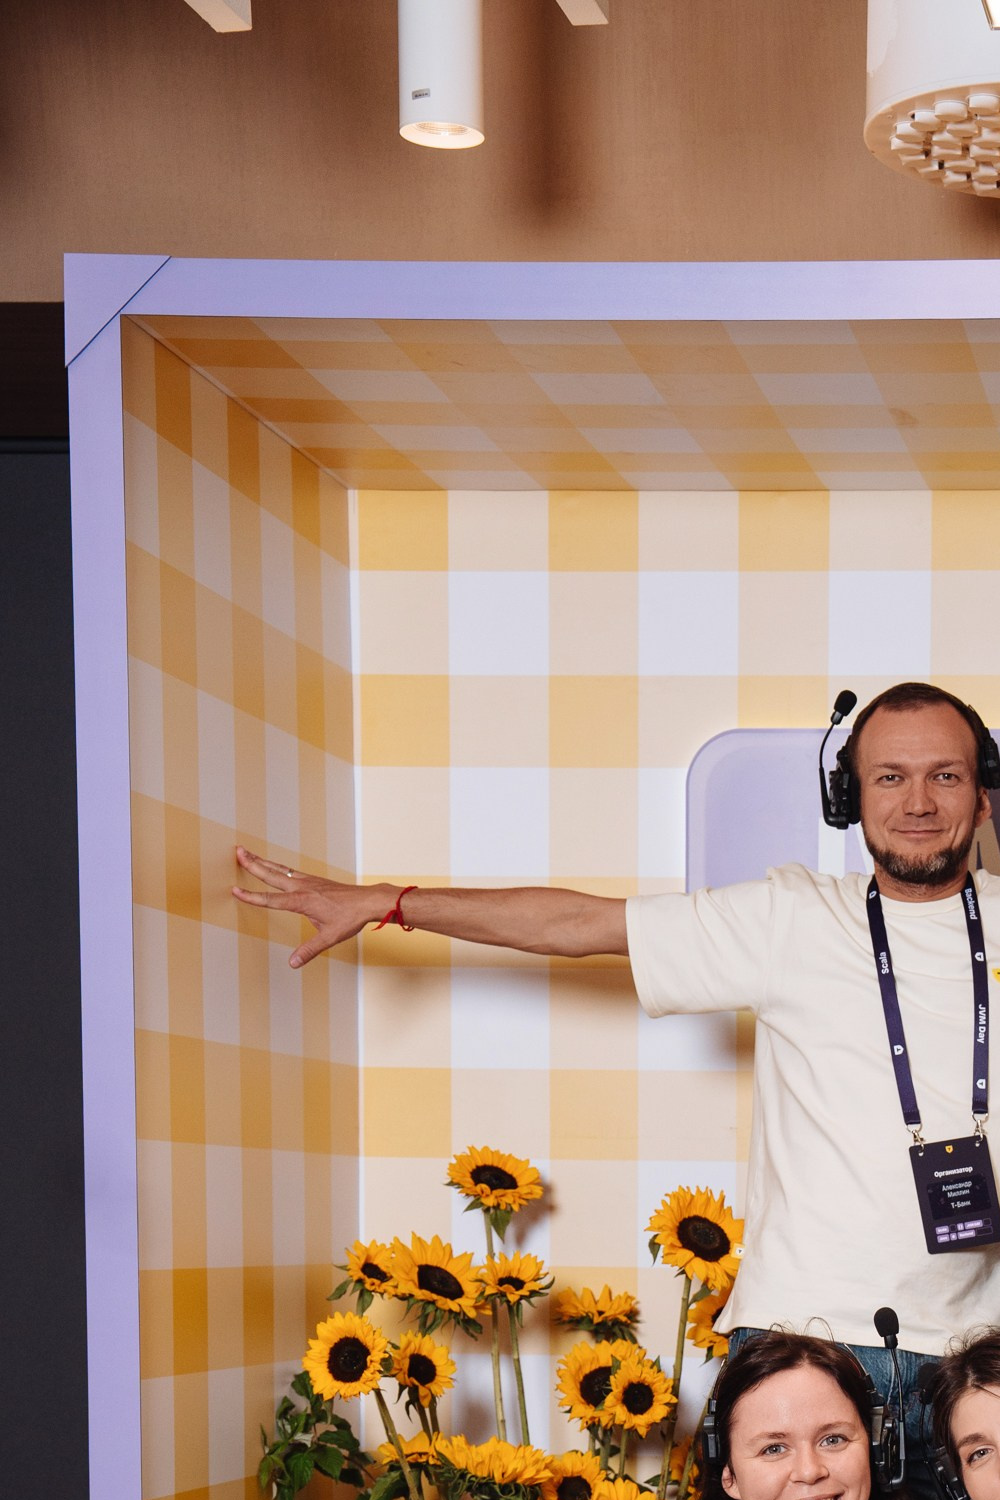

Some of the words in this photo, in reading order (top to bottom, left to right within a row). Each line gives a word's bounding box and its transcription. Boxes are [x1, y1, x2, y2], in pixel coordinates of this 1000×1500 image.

[965, 888, 978, 920] Backend
[879, 951, 889, 974] Scala
[978, 1004, 987, 1025] JVM
[976, 1026, 986, 1044] Day
[934, 1166, 974, 1178] Организатор
[942, 1180, 973, 1192] Александр
[951, 1200, 971, 1209] Т-Банк
